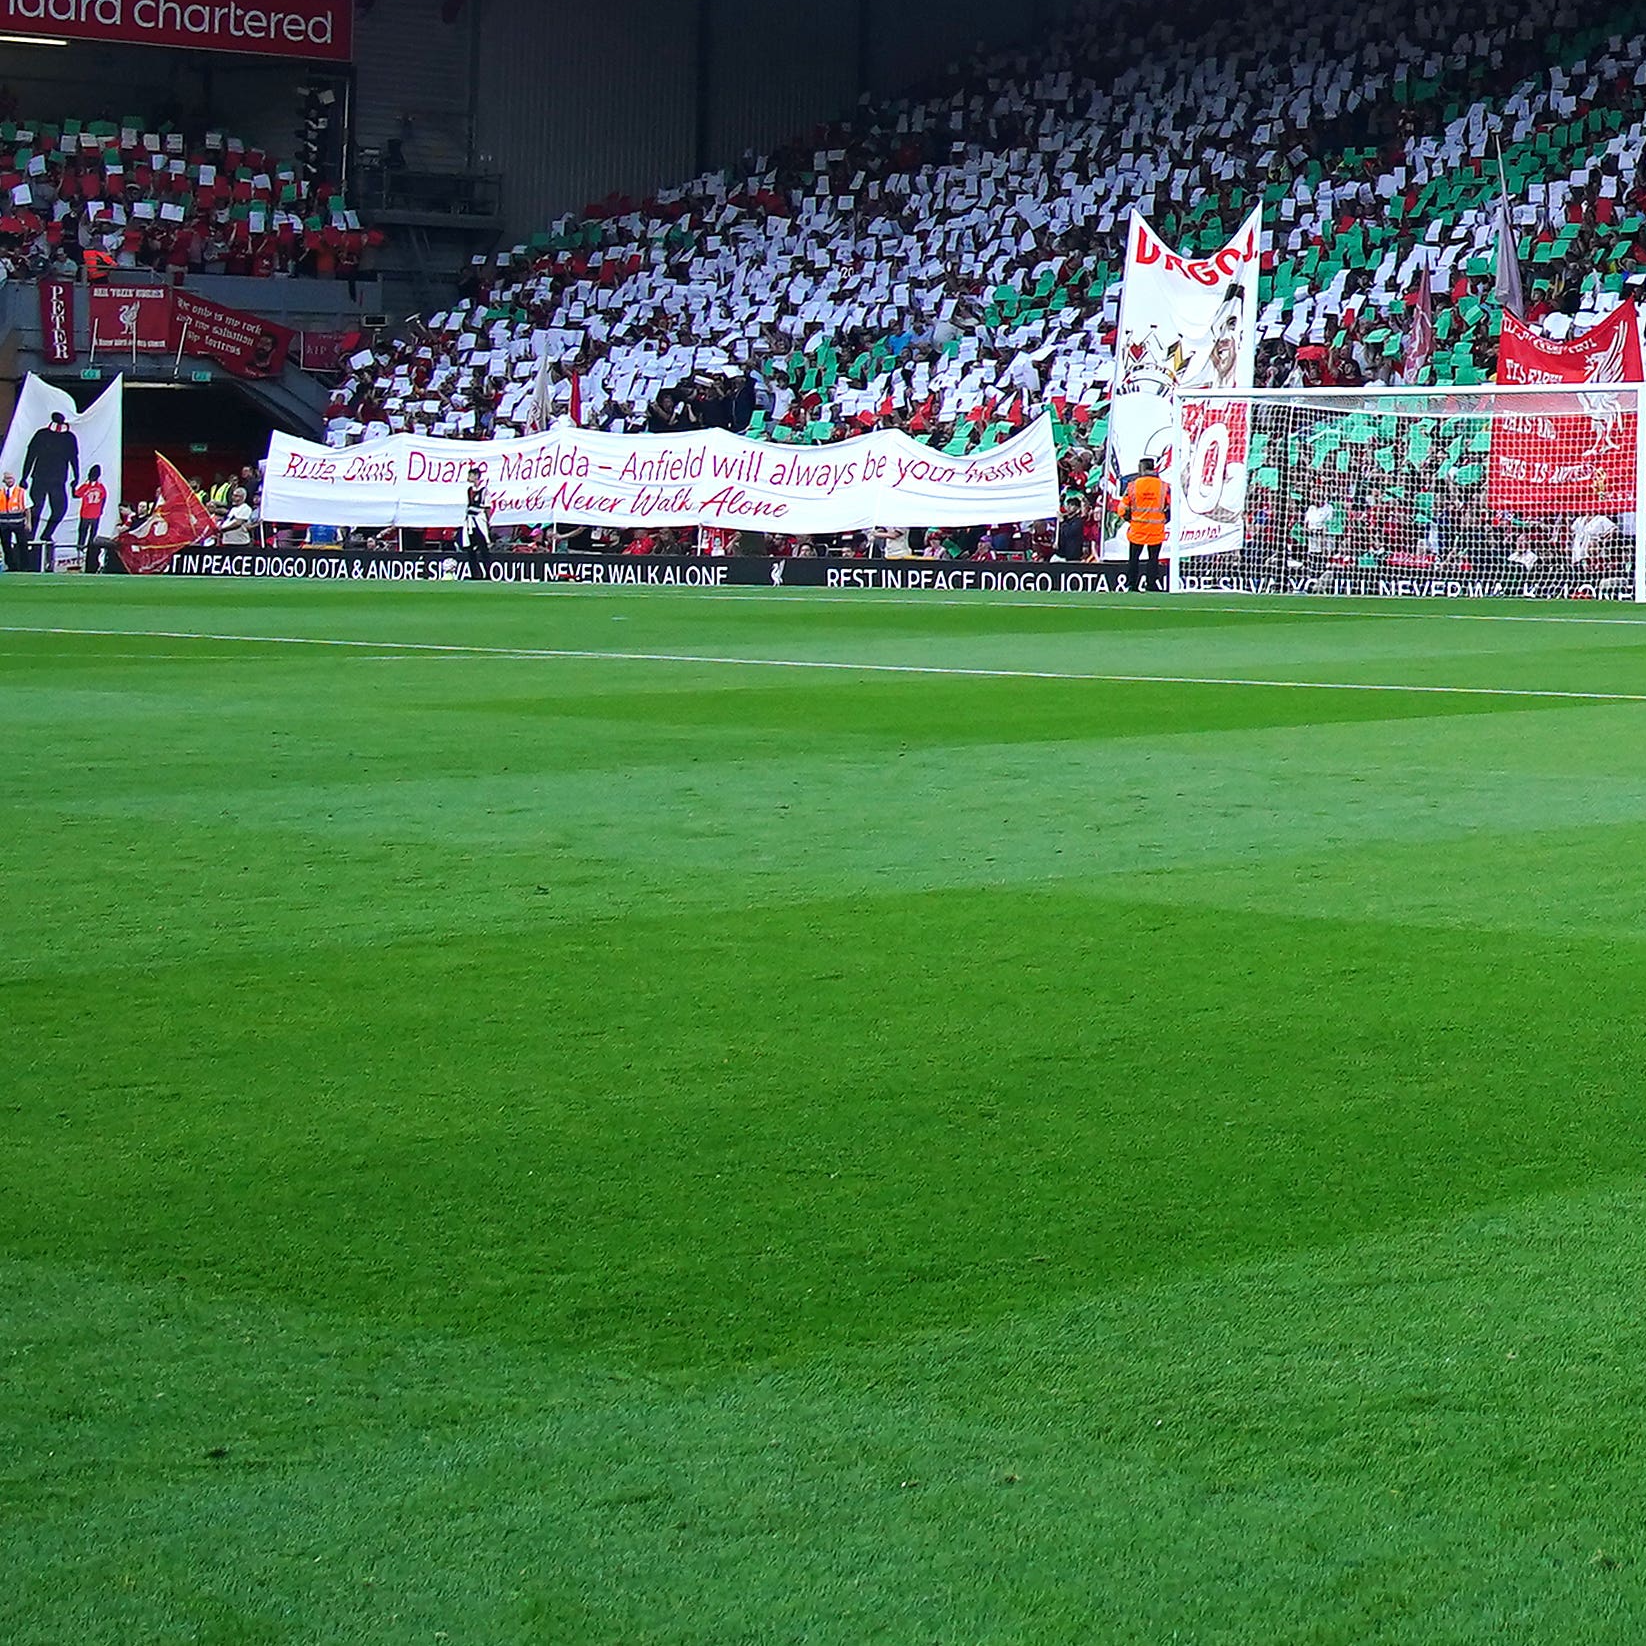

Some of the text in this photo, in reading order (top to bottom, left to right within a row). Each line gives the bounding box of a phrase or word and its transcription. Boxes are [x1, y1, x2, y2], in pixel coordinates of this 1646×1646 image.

[50, 285, 69, 360] PETER
[242, 322, 262, 336] rock
[283, 452, 336, 485] Rute,
[343, 453, 398, 486] Dinis,
[407, 451, 488, 486] Duarte,
[499, 444, 590, 481] Mafalda
[619, 445, 707, 481] Anfield
[713, 450, 763, 483] will
[769, 454, 857, 495] always
[862, 450, 887, 482] be
[891, 457, 955, 488] your
[965, 452, 1035, 483] home
[551, 481, 626, 514] Never
[629, 485, 695, 517] Walk
[698, 485, 789, 518] Alone
[182, 555, 199, 573] IN
[202, 555, 252, 575] PEACE
[254, 556, 306, 577] DIOGO
[308, 558, 349, 579] JOTA
[351, 560, 364, 579] &
[365, 557, 426, 580] ANDRÉ
[428, 561, 472, 581] SIVA
[544, 562, 605, 584] NEVER
[607, 564, 659, 585] WALK
[662, 566, 728, 586] ALONE
[826, 568, 877, 589] REST
[881, 569, 902, 590] IN
[907, 569, 975, 591] PEACE
[980, 571, 1053, 592] DIOGO
[1115, 573, 1130, 592] &
